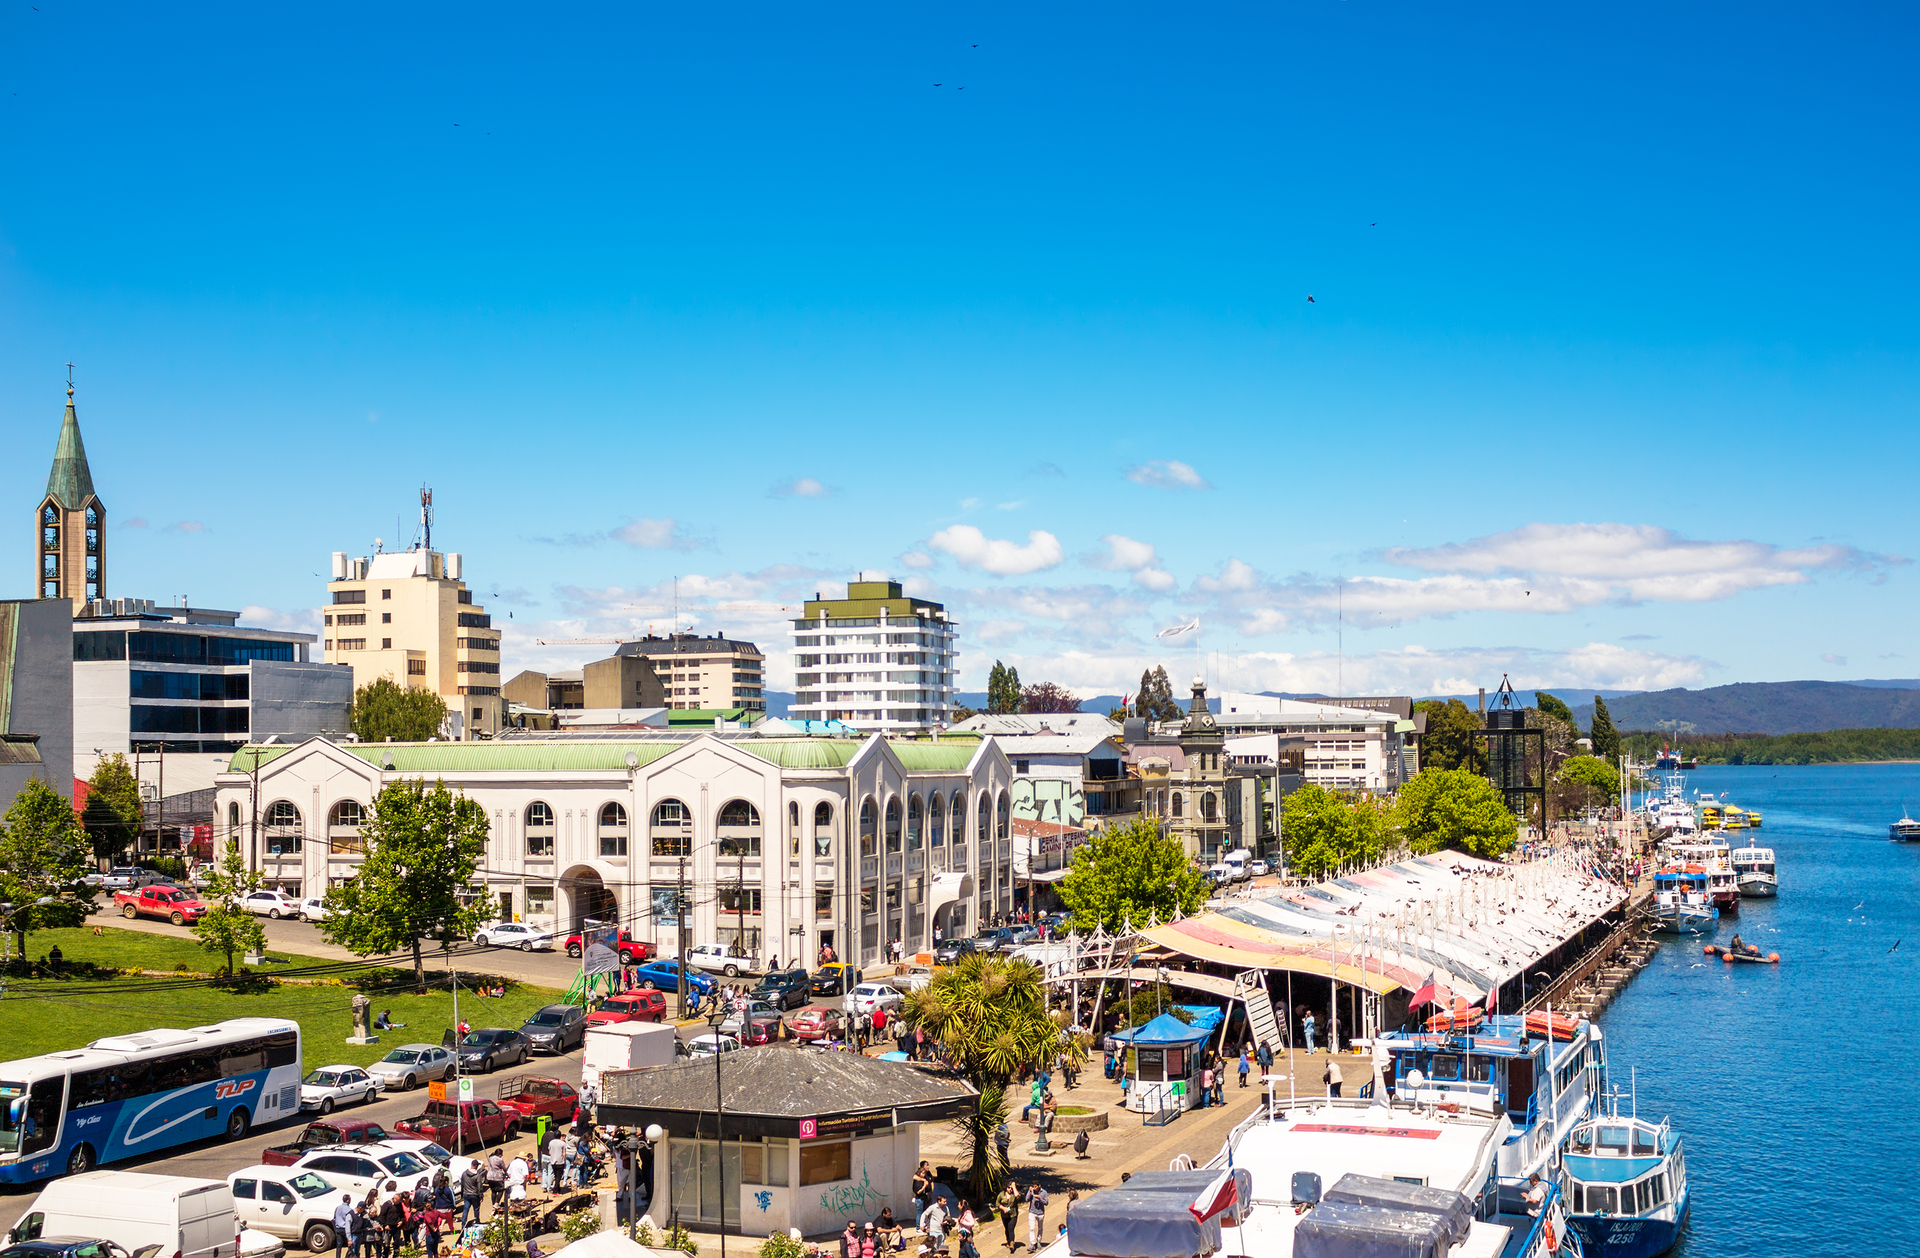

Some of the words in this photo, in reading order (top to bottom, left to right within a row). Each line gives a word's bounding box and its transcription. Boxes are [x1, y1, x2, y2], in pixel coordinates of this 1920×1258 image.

[1041, 835, 1058, 845] FERIA
[215, 1079, 256, 1100] TLP
[87, 1115, 101, 1124] Class
[1607, 1232, 1635, 1244] 4258
